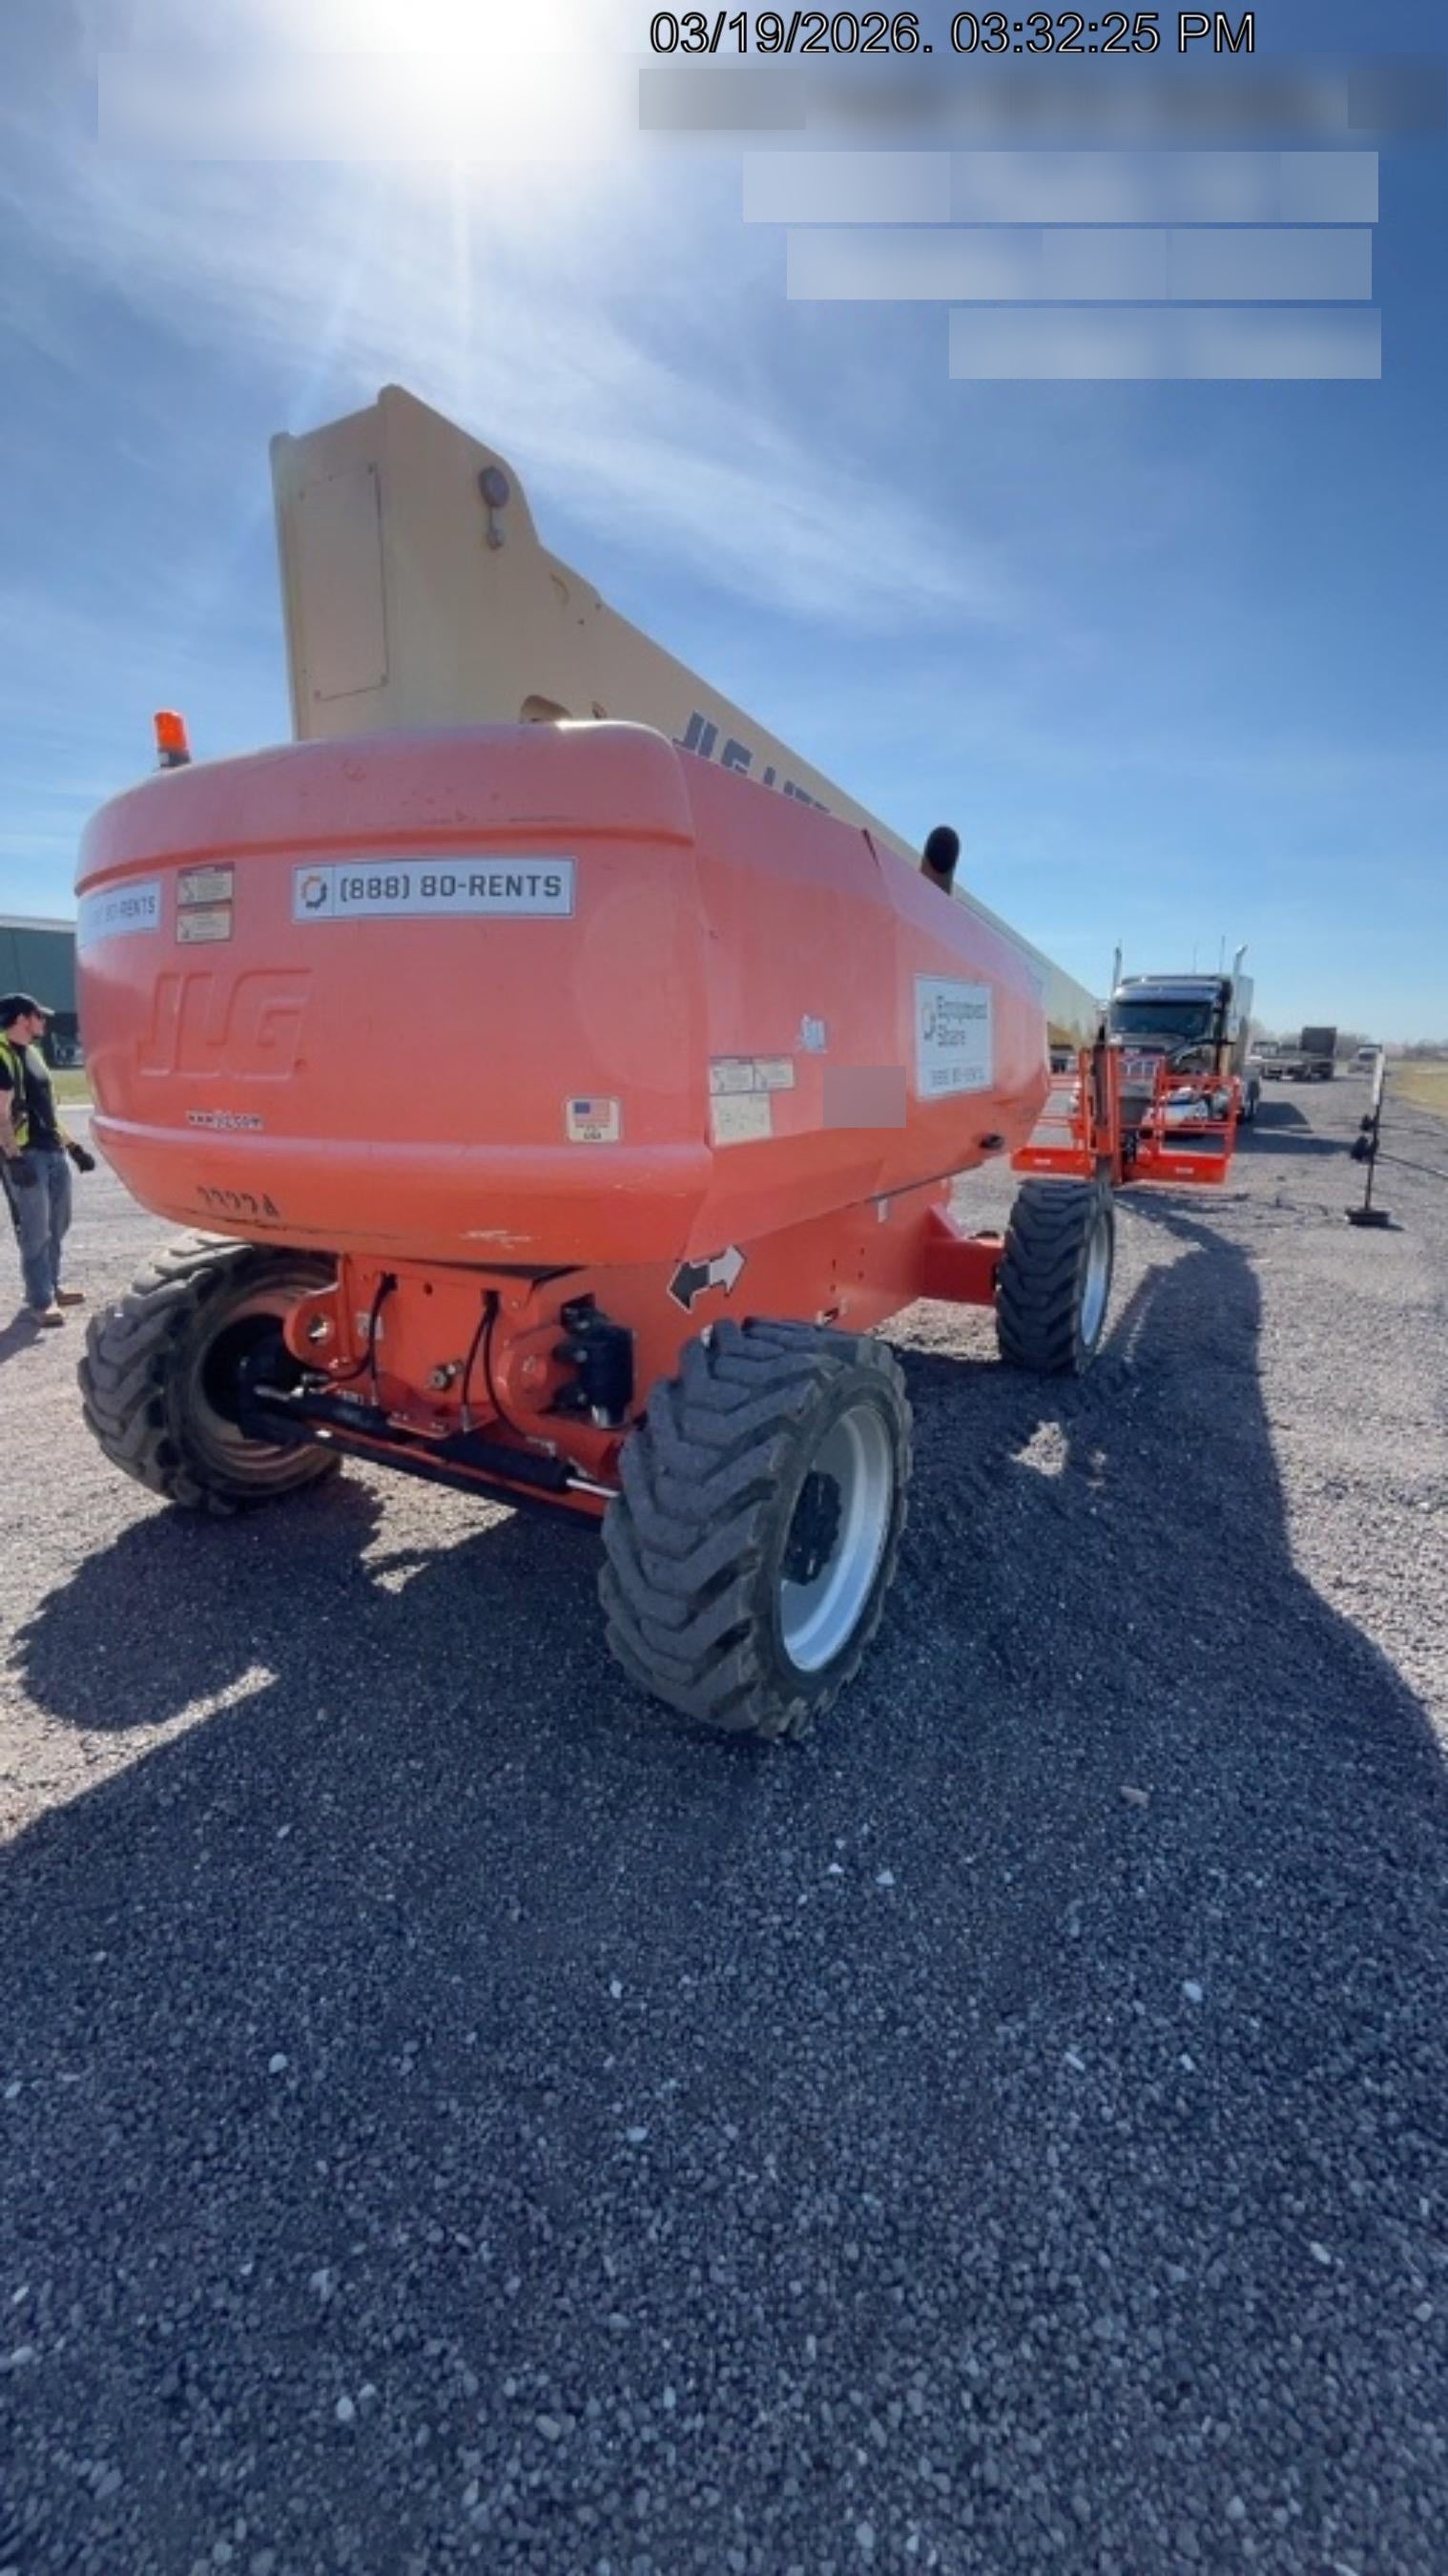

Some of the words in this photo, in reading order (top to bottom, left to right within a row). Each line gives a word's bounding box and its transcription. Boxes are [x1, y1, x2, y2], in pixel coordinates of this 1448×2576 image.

[340, 875, 410, 903] (888)
[420, 874, 563, 898] 80-RENTS
[136, 967, 314, 1082] JLG
